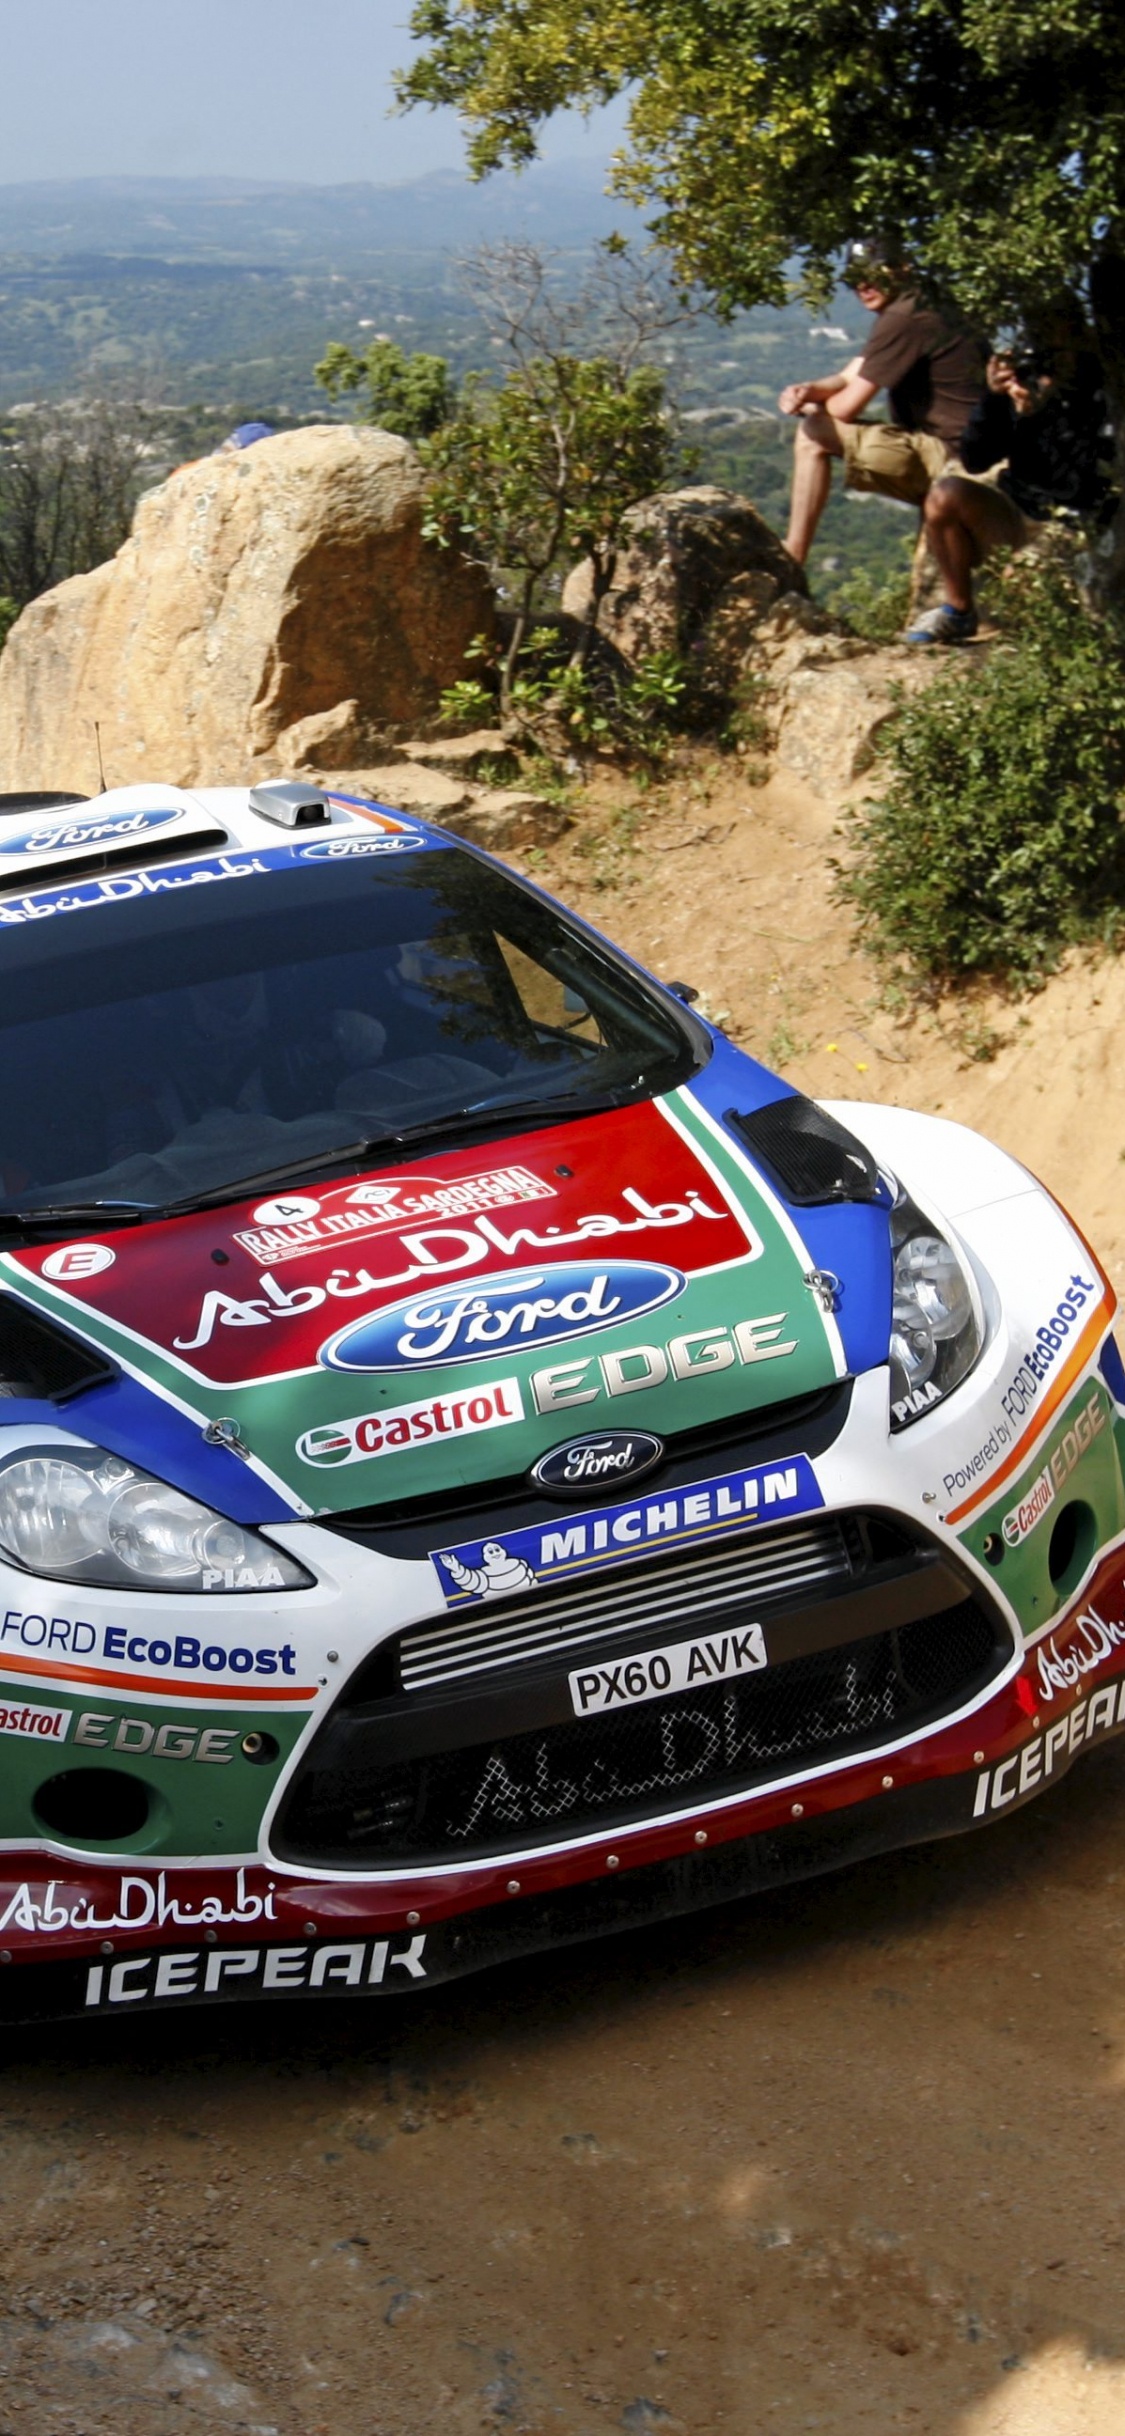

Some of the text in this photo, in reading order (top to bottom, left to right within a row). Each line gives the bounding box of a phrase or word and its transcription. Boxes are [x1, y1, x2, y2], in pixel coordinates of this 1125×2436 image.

[25, 813, 150, 851] Ford
[328, 838, 404, 856] Ford
[241, 1168, 539, 1254] RALLY ITALIA SARDEGNA
[274, 1204, 304, 1217] 4
[435, 1198, 495, 1217] 2011
[58, 1251, 97, 1274] E
[397, 1275, 622, 1359] Ford
[355, 1311, 799, 1452] Castrol EDGE
[891, 1381, 942, 1422] PIAA
[942, 1274, 1095, 1497] Powered by FORD EcoBoost
[564, 1440, 635, 1482] Ford
[1017, 1391, 1106, 1533] Castrol EDGE
[541, 1468, 797, 1564] MICHELIN
[202, 1567, 286, 1590] PIAA
[0, 1611, 297, 1675] FORD EcoBoost
[577, 1631, 760, 1710] PX60 AVK
[0, 1707, 240, 1764] astrol EDGE
[85, 1934, 428, 2006] ICEPEAK
